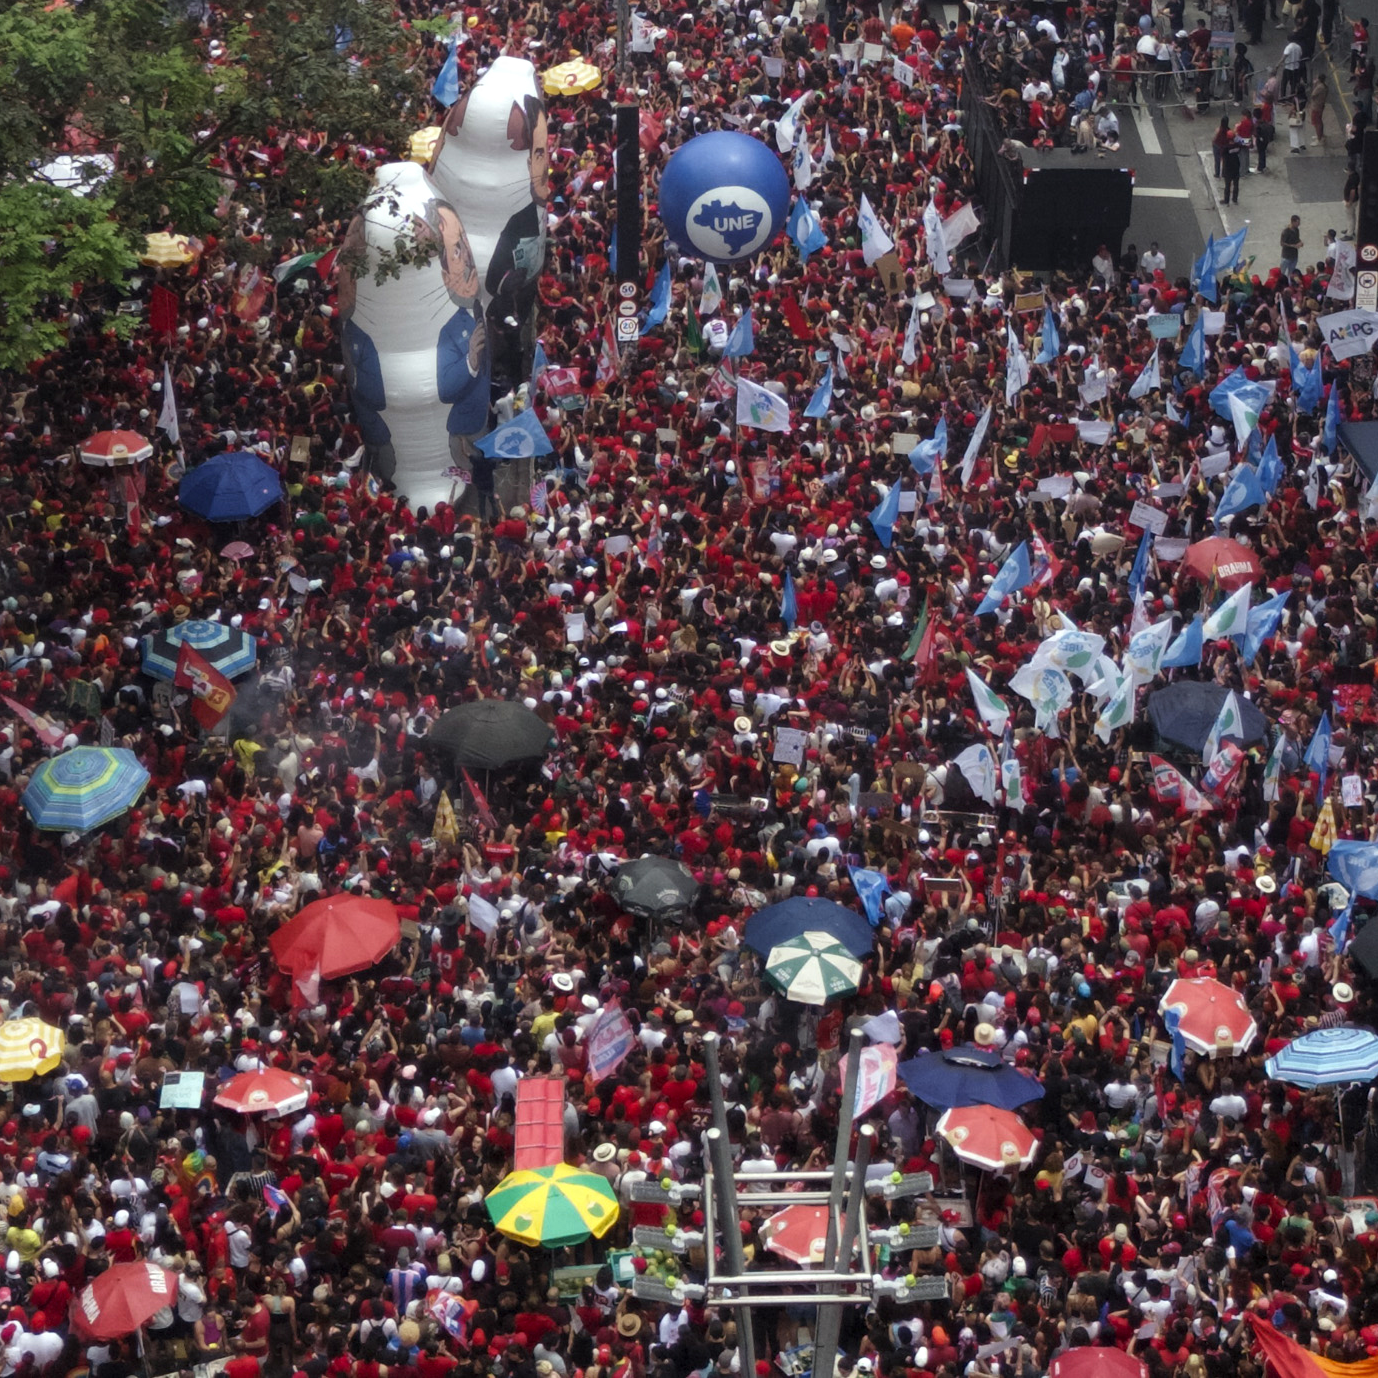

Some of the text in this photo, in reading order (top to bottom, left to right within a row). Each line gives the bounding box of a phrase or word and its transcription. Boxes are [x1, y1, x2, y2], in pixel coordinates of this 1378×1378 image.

[714, 213, 755, 232] UNE
[1363, 248, 1376, 257] 50
[622, 285, 634, 294] 50
[622, 322, 634, 330] 20
[1218, 561, 1253, 579] BRAHMA
[436, 951, 452, 970] 13
